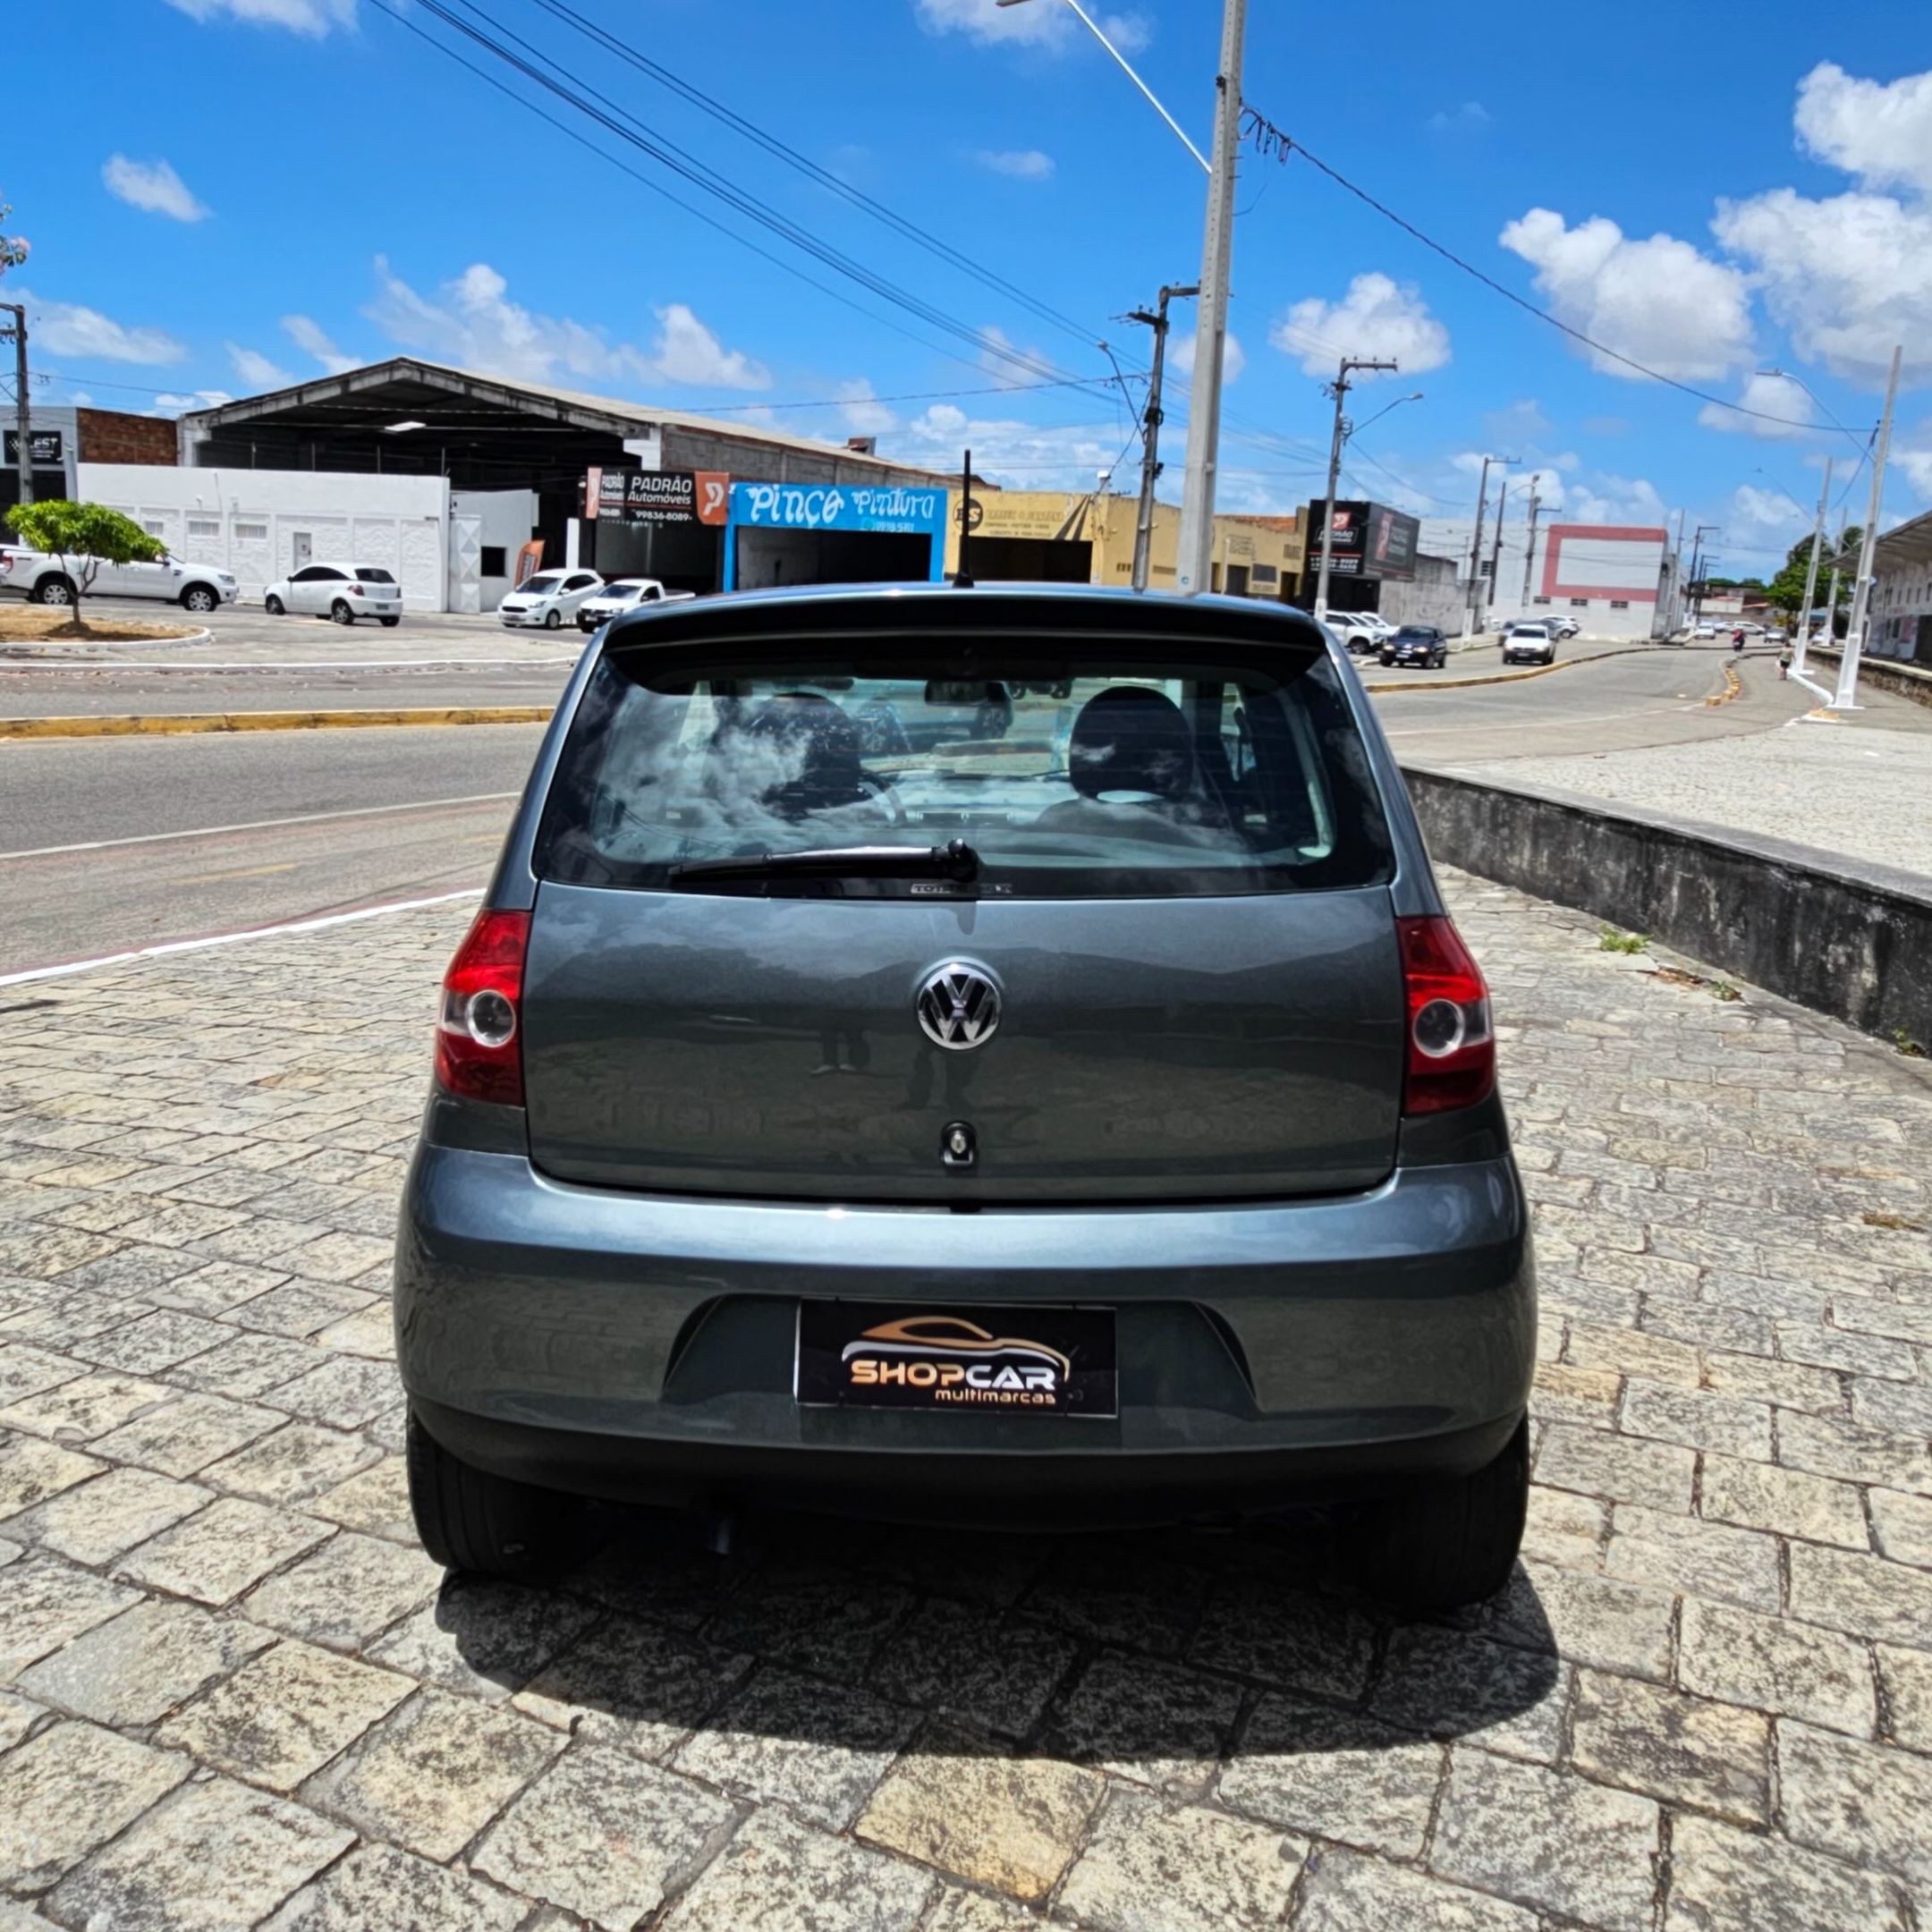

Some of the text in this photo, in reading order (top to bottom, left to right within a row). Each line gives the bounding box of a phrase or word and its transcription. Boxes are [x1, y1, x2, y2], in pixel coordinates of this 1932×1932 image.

[631, 476, 692, 493] PADRÃO
[627, 491, 691, 504] Automóveis
[851, 1360, 1055, 1391] SHOPCAR
[935, 1387, 1056, 1405] multimarcas
